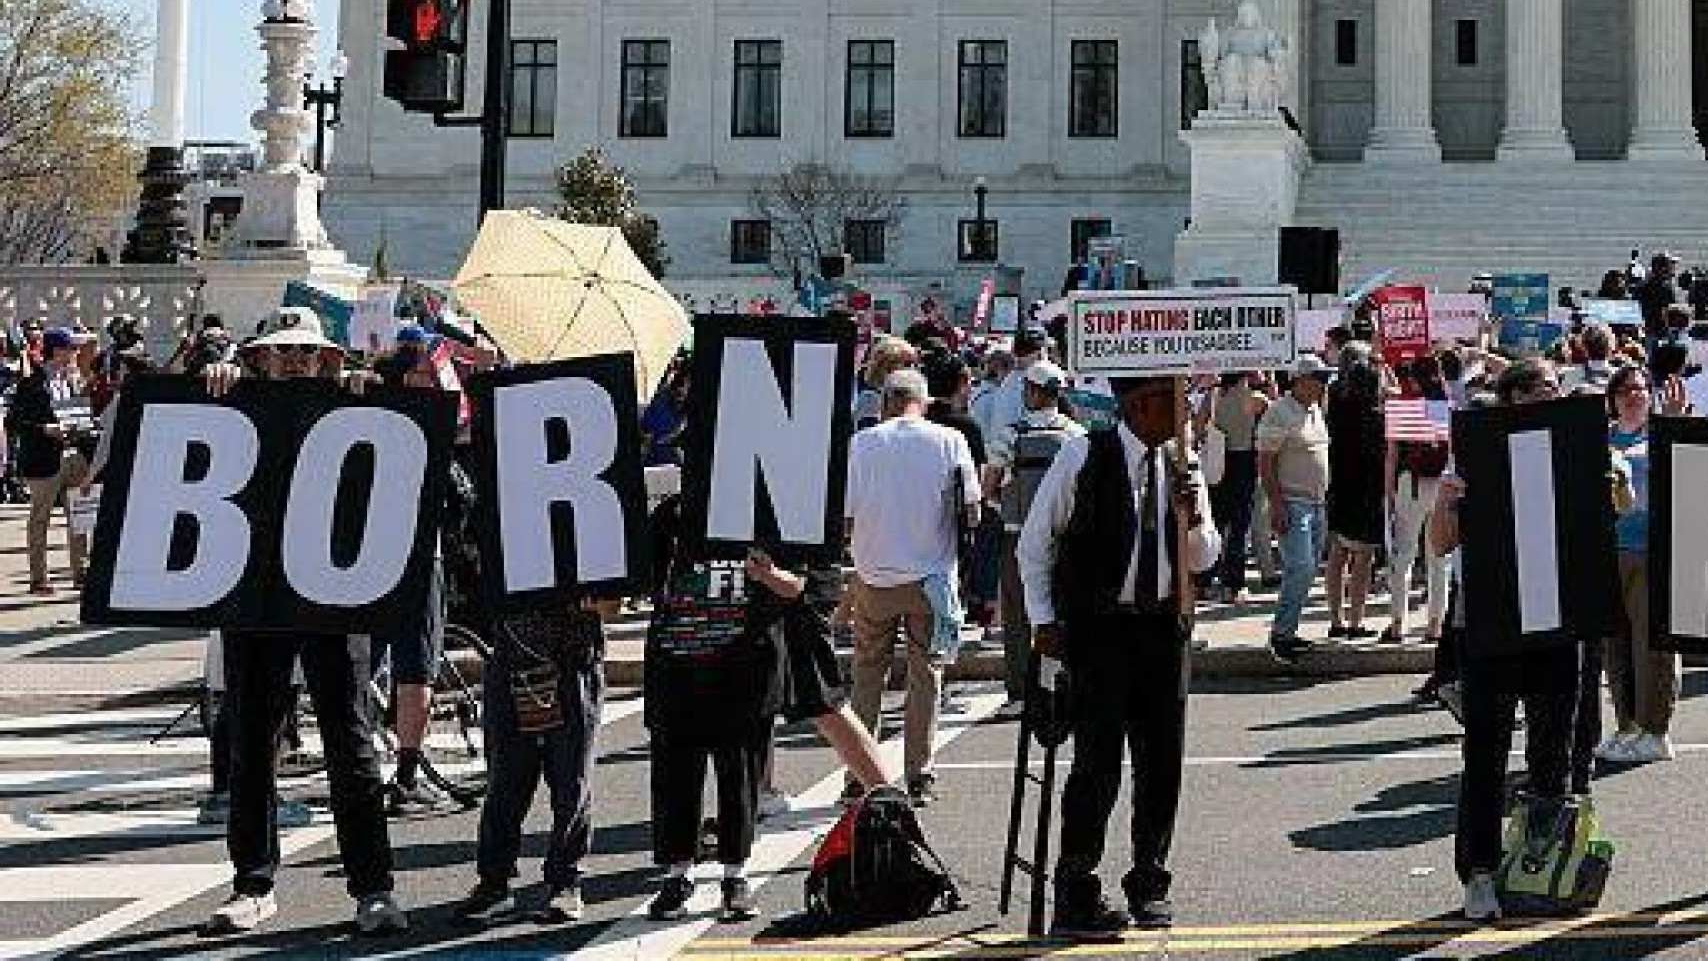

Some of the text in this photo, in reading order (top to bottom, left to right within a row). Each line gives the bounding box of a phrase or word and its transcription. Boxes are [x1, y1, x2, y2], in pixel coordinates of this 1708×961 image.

[1083, 305, 1286, 334] STOP HATING EACH OTHER
[1083, 339, 1149, 358] BECAUSE
[1153, 337, 1181, 355] YOU
[109, 336, 838, 612] BORN
